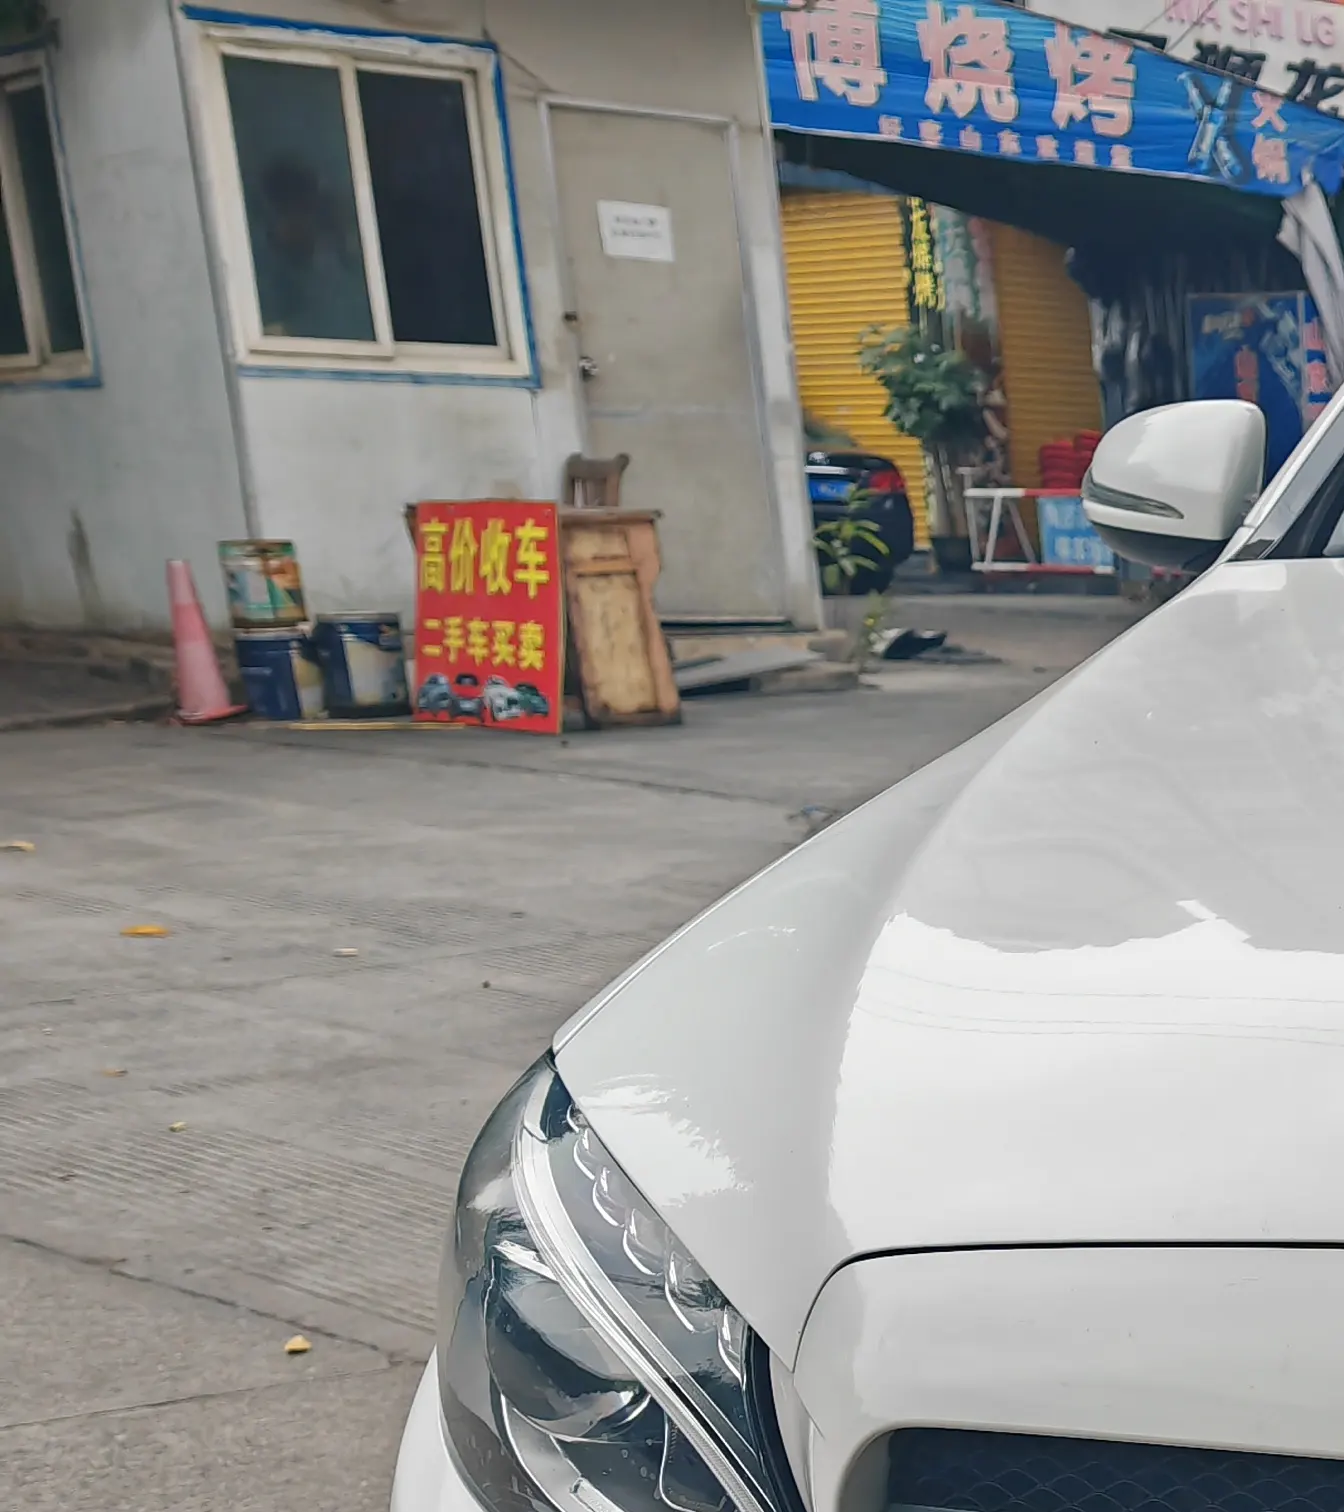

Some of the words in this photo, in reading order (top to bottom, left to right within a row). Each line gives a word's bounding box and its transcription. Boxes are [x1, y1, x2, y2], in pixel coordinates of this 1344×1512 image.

[420, 516, 550, 599] 高价收车
[421, 616, 546, 671] 二手车买卖
